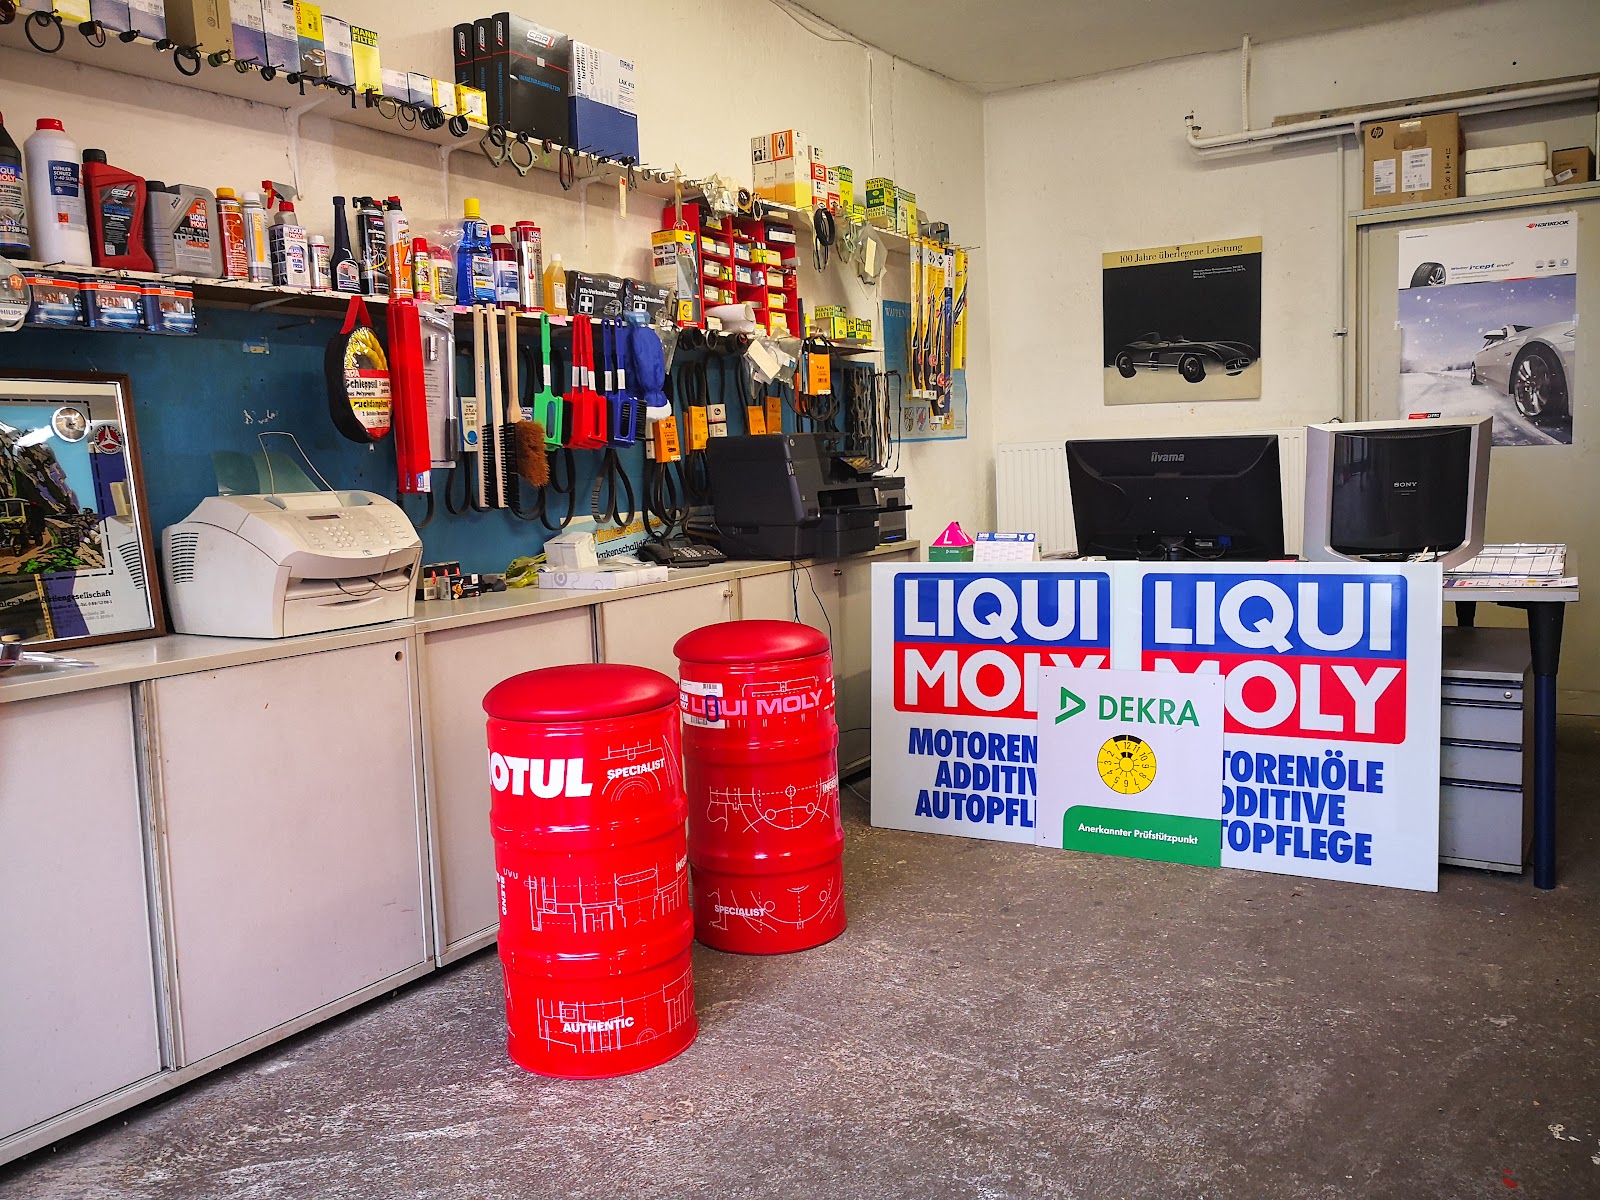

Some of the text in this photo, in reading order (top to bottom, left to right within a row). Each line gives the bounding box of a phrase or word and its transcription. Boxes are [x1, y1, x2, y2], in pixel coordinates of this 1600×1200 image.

[352, 27, 377, 39] MANN
[353, 34, 378, 46] FILTER
[1371, 127, 1383, 139] hp
[0, 167, 15, 175] QUI
[190, 214, 206, 222] LIQUI
[190, 220, 207, 229] MOLY
[174, 233, 193, 241] TOP
[289, 232, 304, 240] MOLY
[1120, 244, 1243, 264] 100 Jahre überlegene Leistung
[9, 277, 22, 288] H7
[904, 577, 1098, 644] LIQUI
[1154, 579, 1392, 654] LIQUI
[904, 648, 1107, 712] MOL
[756, 688, 823, 717] MOLY
[1154, 658, 1402, 734] OLY
[1098, 694, 1200, 727] DEKRA
[908, 727, 1038, 763] MOTOREN
[1123, 741, 1131, 750] 12
[1132, 744, 1141, 754] 11
[1139, 752, 1149, 762] 10
[488, 750, 594, 799] OTUL
[606, 757, 666, 780] SPECIALIST
[1223, 749, 1384, 794] ORENÖLE
[935, 761, 1037, 797] ADDITI
[1113, 776, 1121, 784] 5
[914, 789, 1037, 829] AUTOPFL
[1077, 822, 1199, 845] Anerkannter Prüfstützpunkt
[1221, 820, 1373, 866] OPFLEGE
[714, 904, 766, 917] SPECIALIST
[562, 1015, 635, 1034] AUTHENTIC
